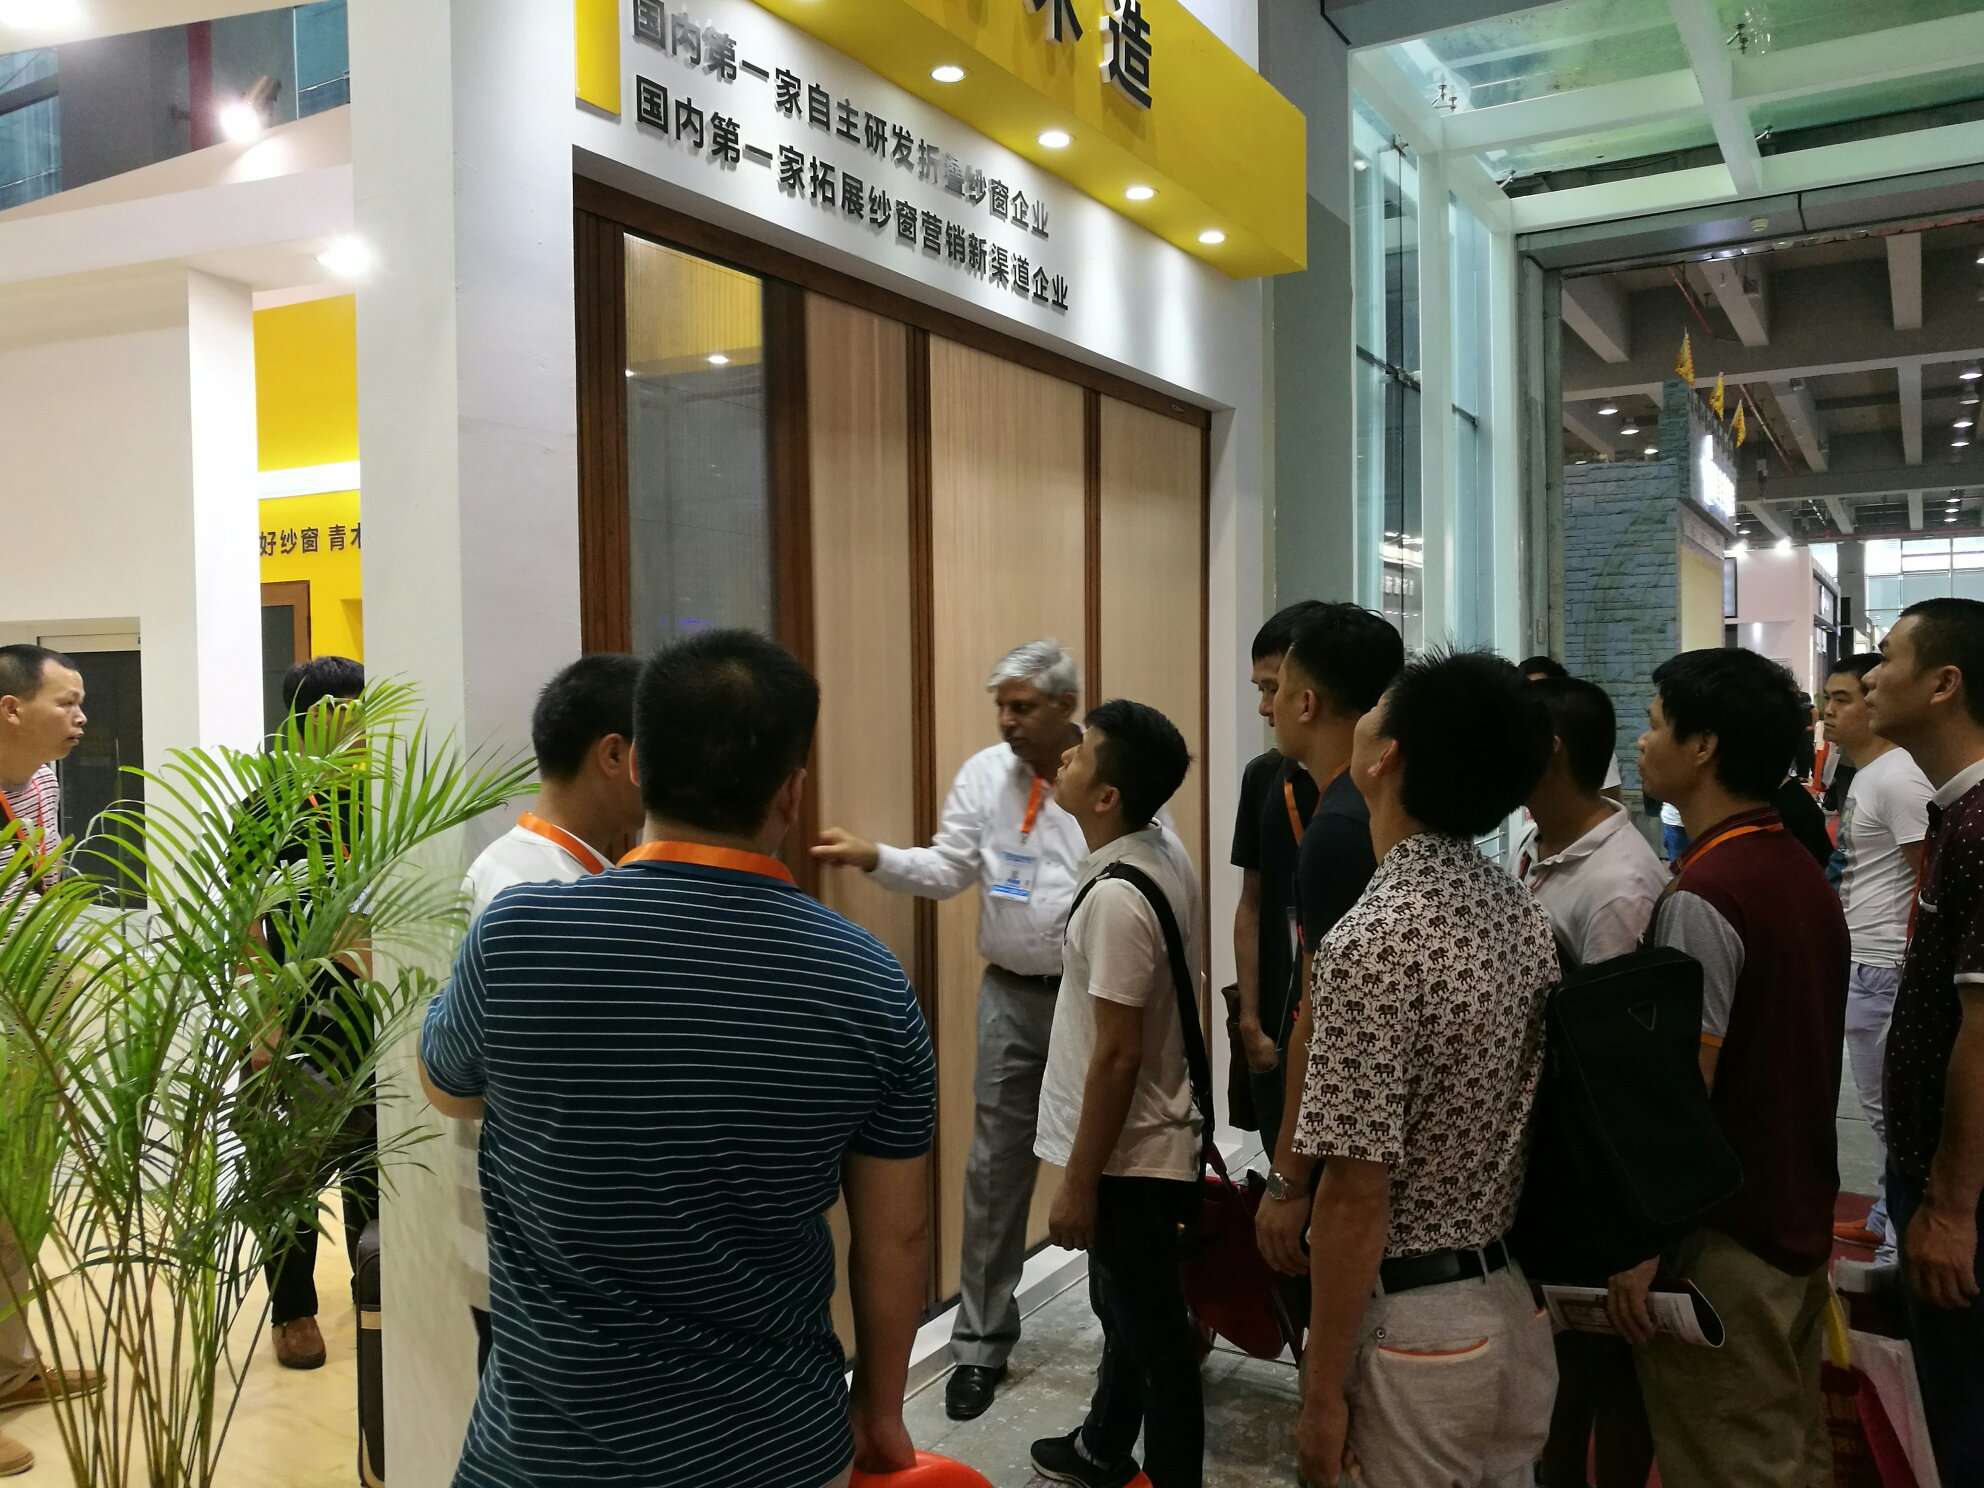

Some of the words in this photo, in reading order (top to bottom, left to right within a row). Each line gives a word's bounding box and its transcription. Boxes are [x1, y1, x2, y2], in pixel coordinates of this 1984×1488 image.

[636, 75, 1068, 310] 国内第一家拓展纱窗营销新渠道企业
[259, 527, 319, 556] 好纱窗
